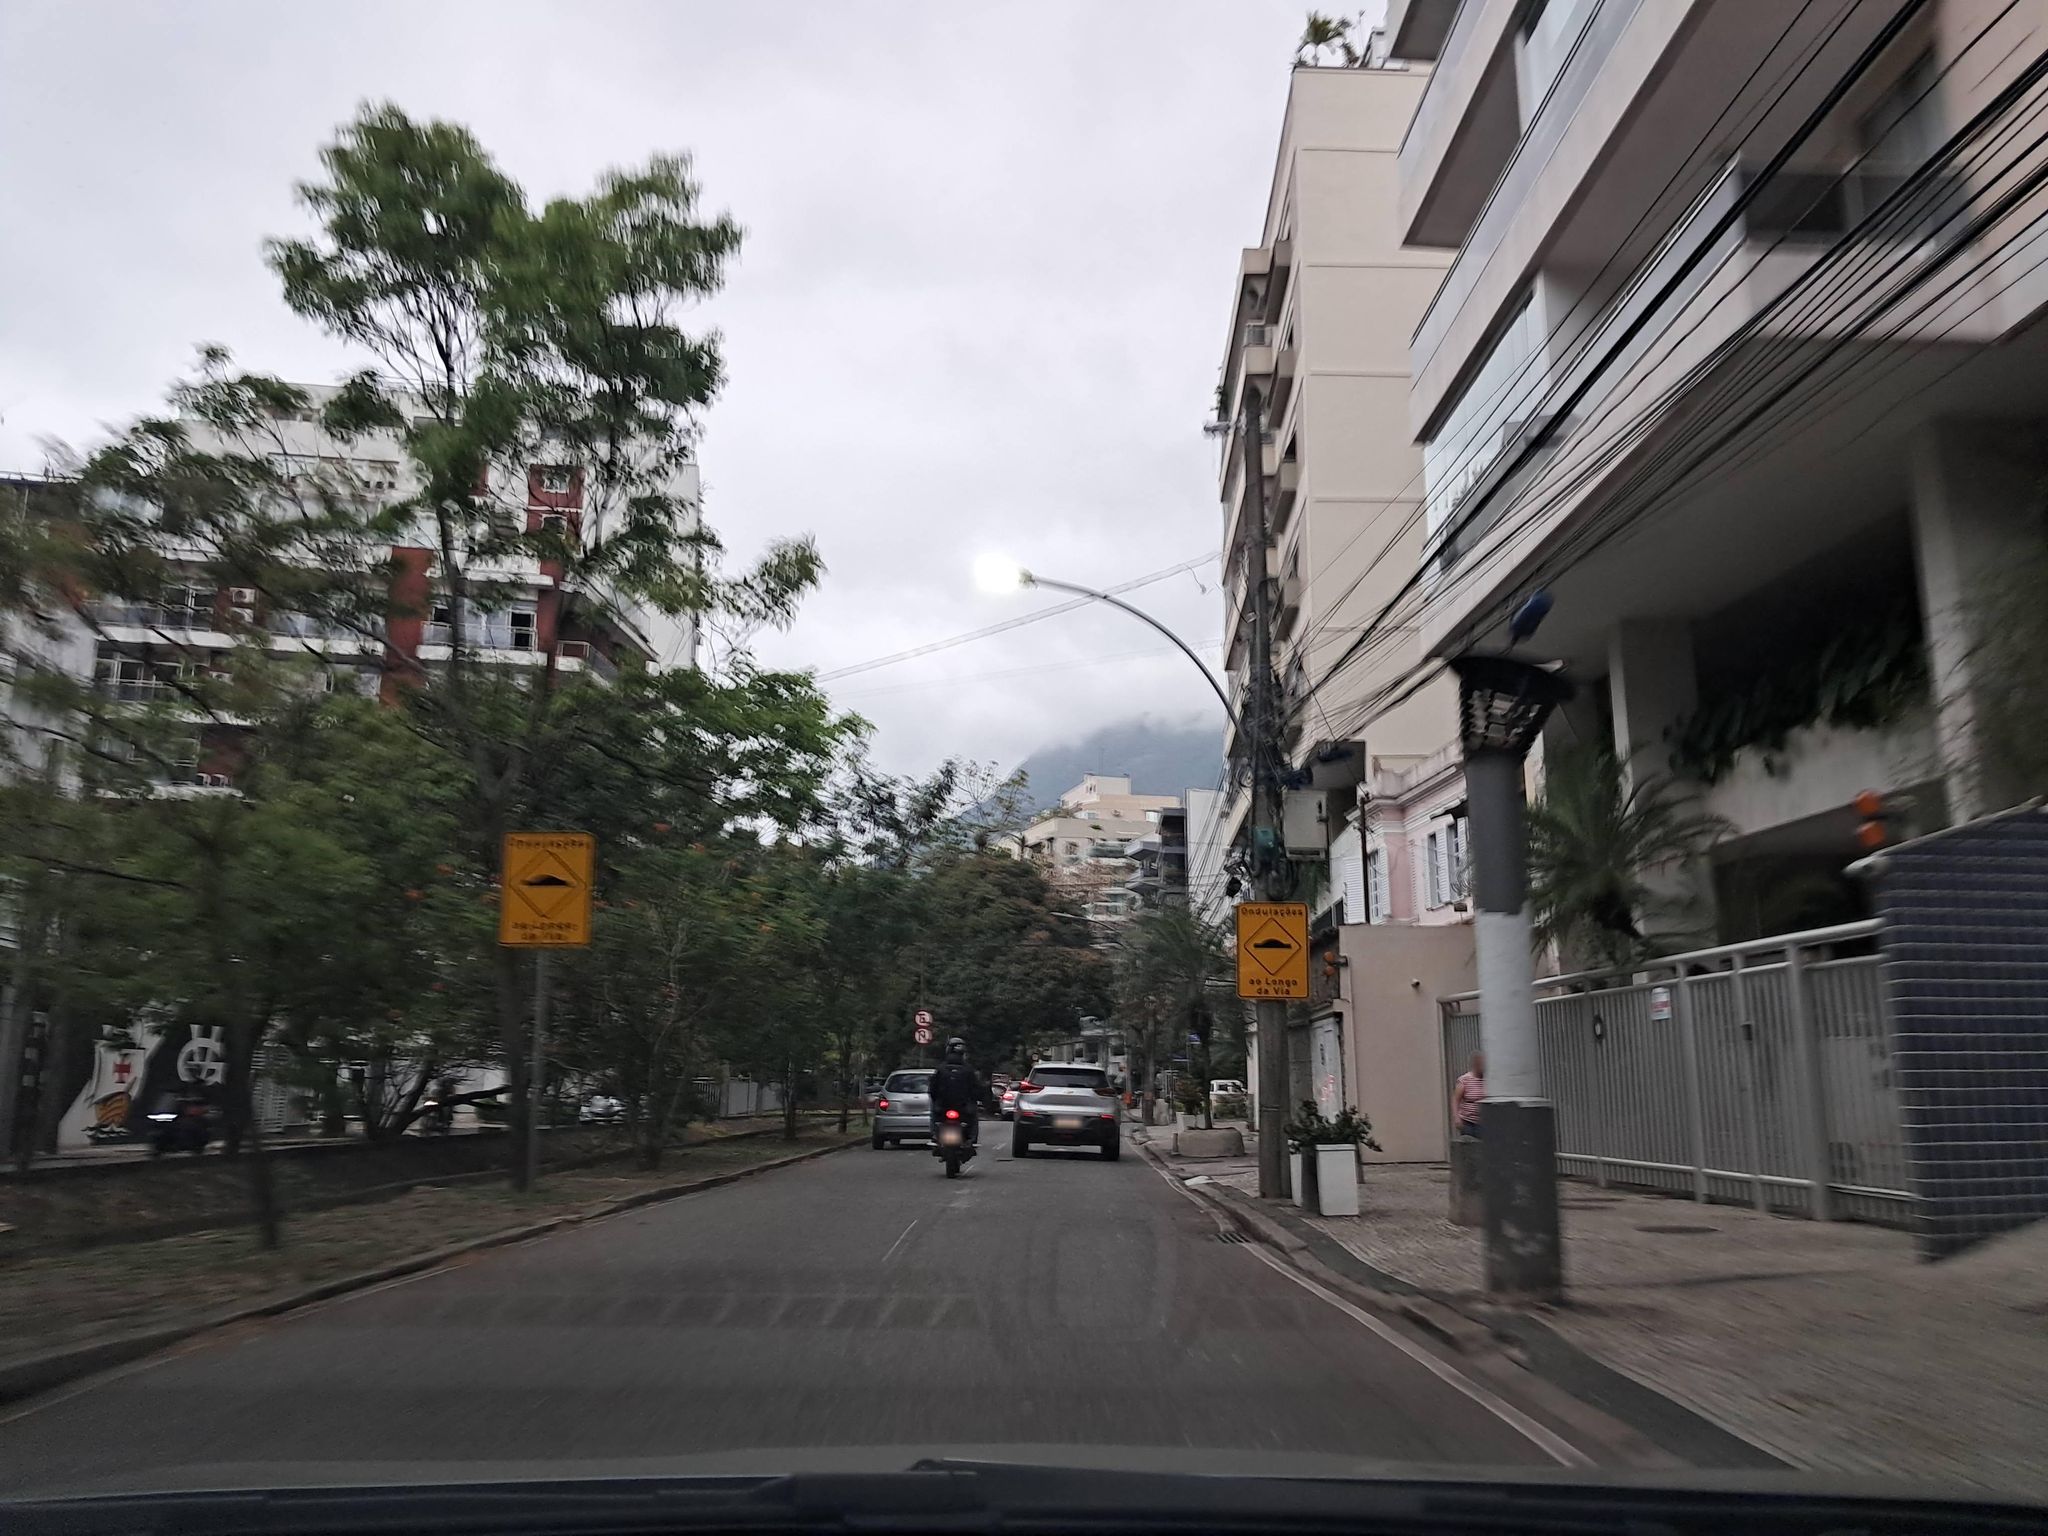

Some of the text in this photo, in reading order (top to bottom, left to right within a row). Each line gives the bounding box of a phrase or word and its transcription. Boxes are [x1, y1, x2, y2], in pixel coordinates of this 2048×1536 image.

[1265, 978, 1298, 987] Longo
[1256, 987, 1290, 995] da Via
